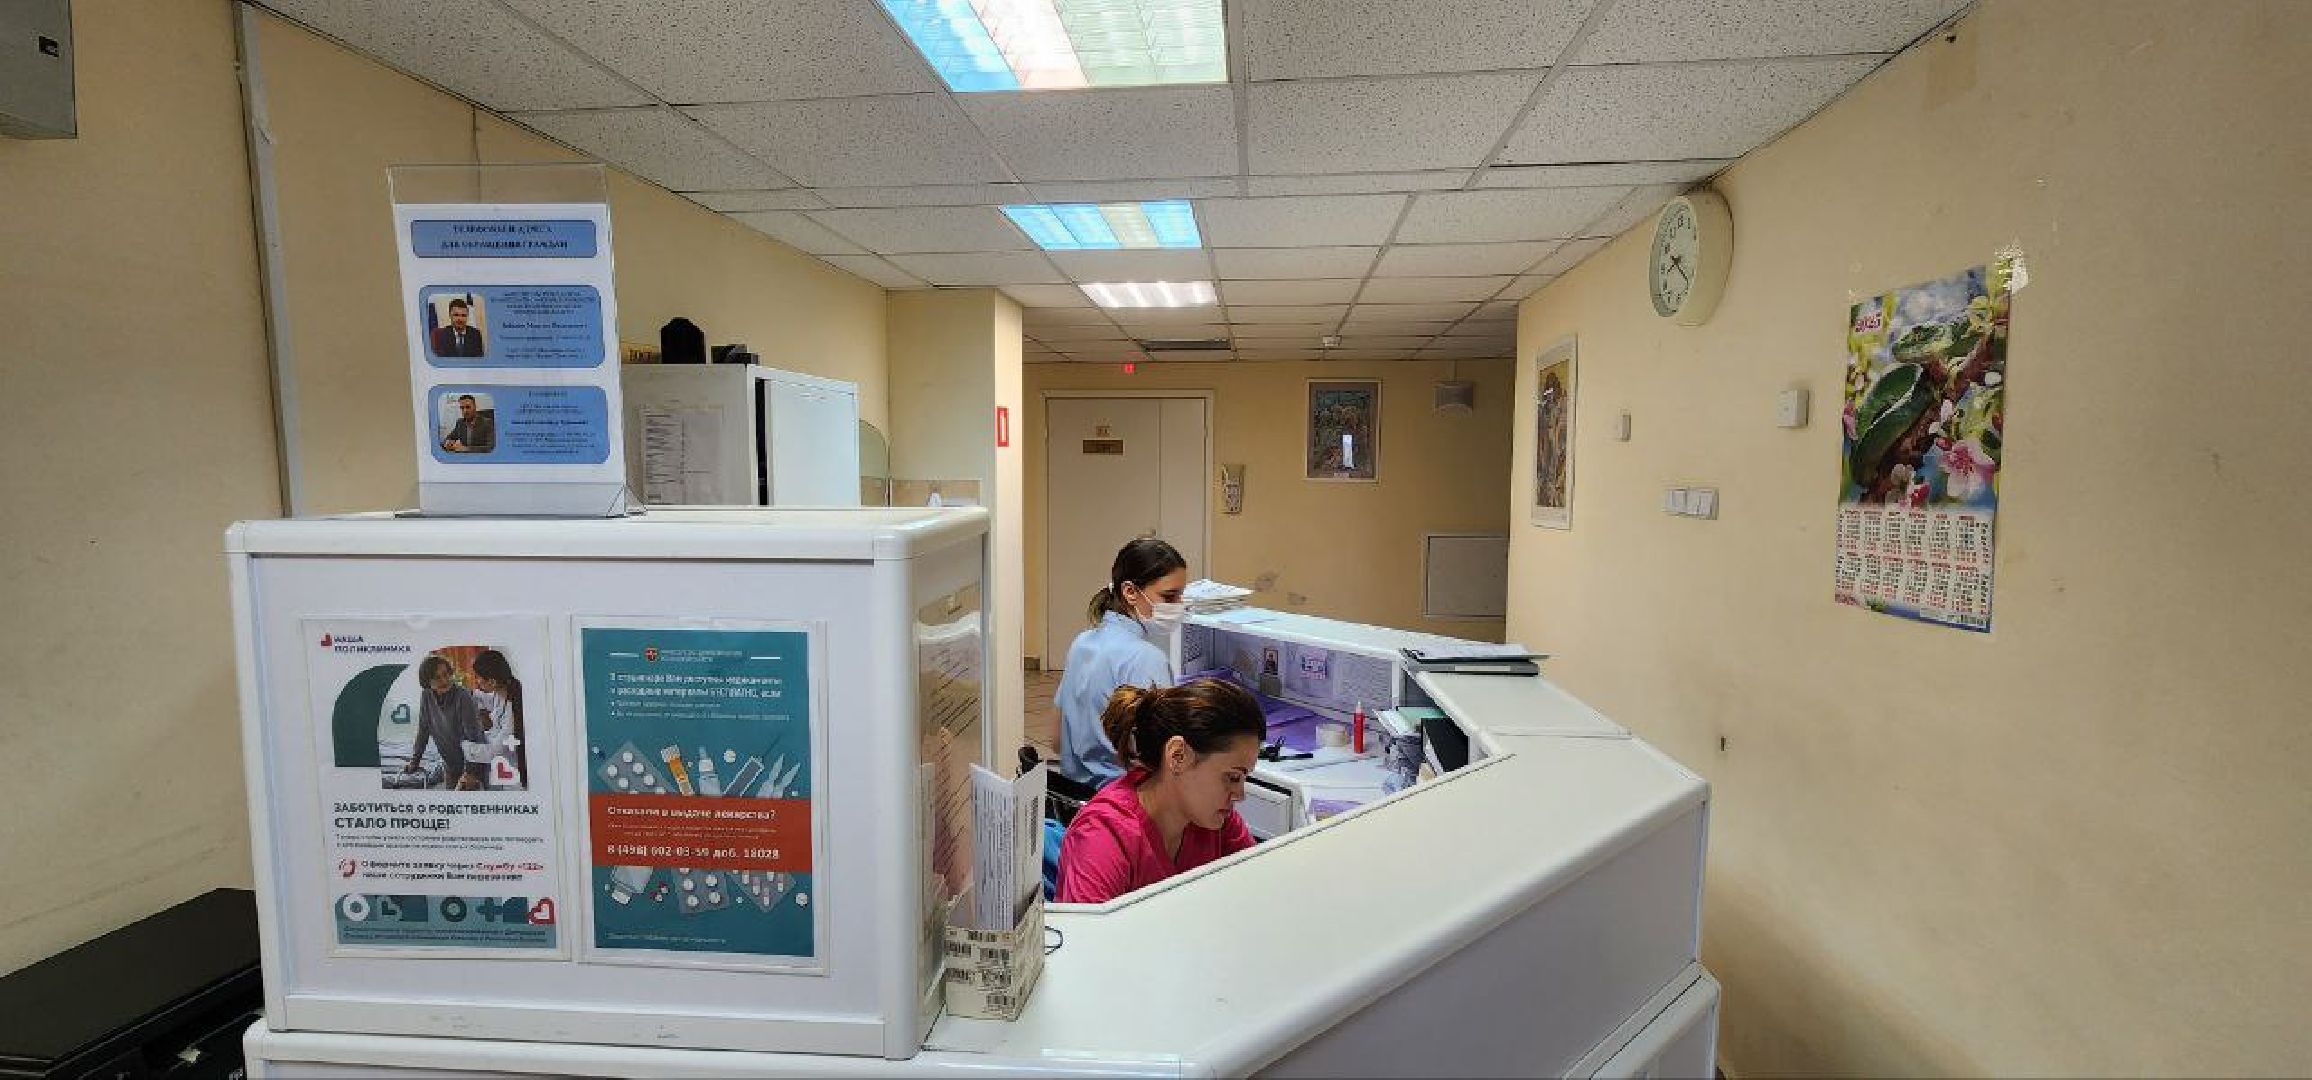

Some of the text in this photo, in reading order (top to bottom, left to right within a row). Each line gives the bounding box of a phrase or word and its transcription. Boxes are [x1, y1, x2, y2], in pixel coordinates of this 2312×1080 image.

[335, 645, 411, 654] ПОЛИКЛИНИКА
[334, 802, 539, 815] ЗАБОТИТЬСЯ О РОДСТВЕННИКАХ
[608, 806, 660, 816] Отказали
[714, 809, 776, 820] лекарства?
[334, 817, 450, 832] СТАЛО ПРОЩЕ!
[712, 848, 740, 859] доб.
